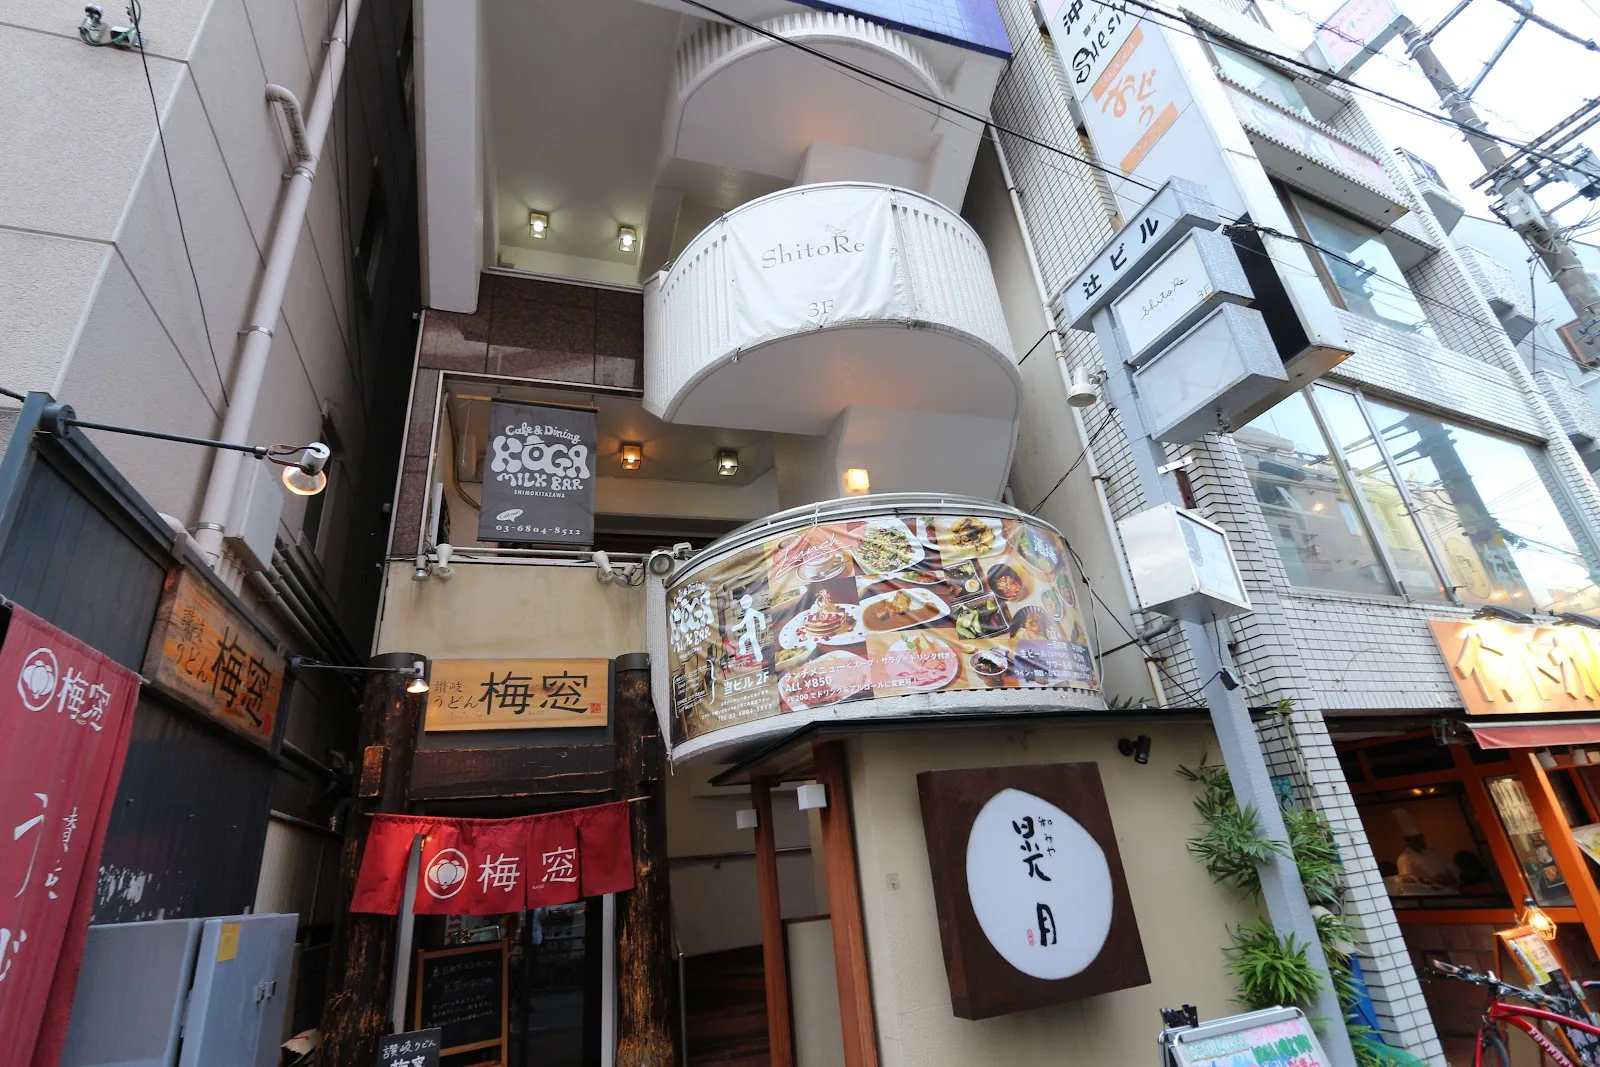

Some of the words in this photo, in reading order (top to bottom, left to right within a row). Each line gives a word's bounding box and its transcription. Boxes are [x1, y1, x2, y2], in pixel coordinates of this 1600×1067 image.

[761, 234, 866, 269] ShitoRe
[1082, 216, 1159, 301] 辻ビル
[1196, 284, 1212, 301] 3F
[807, 299, 835, 318] 3F
[505, 421, 533, 437] Cafe
[533, 425, 543, 435] &
[544, 425, 581, 444] Dining
[490, 435, 591, 479] KOGA
[496, 472, 548, 488] MILK
[551, 476, 584, 491] BAR
[513, 489, 566, 499] SHIMOKITAZAWA
[495, 524, 581, 536] 03-6804-8512
[723, 676, 754, 695] 当ビル
[756, 671, 770, 686] 2F
[784, 684, 802, 694] ALL
[804, 676, 833, 689] ¥850
[433, 694, 479, 710] うどん
